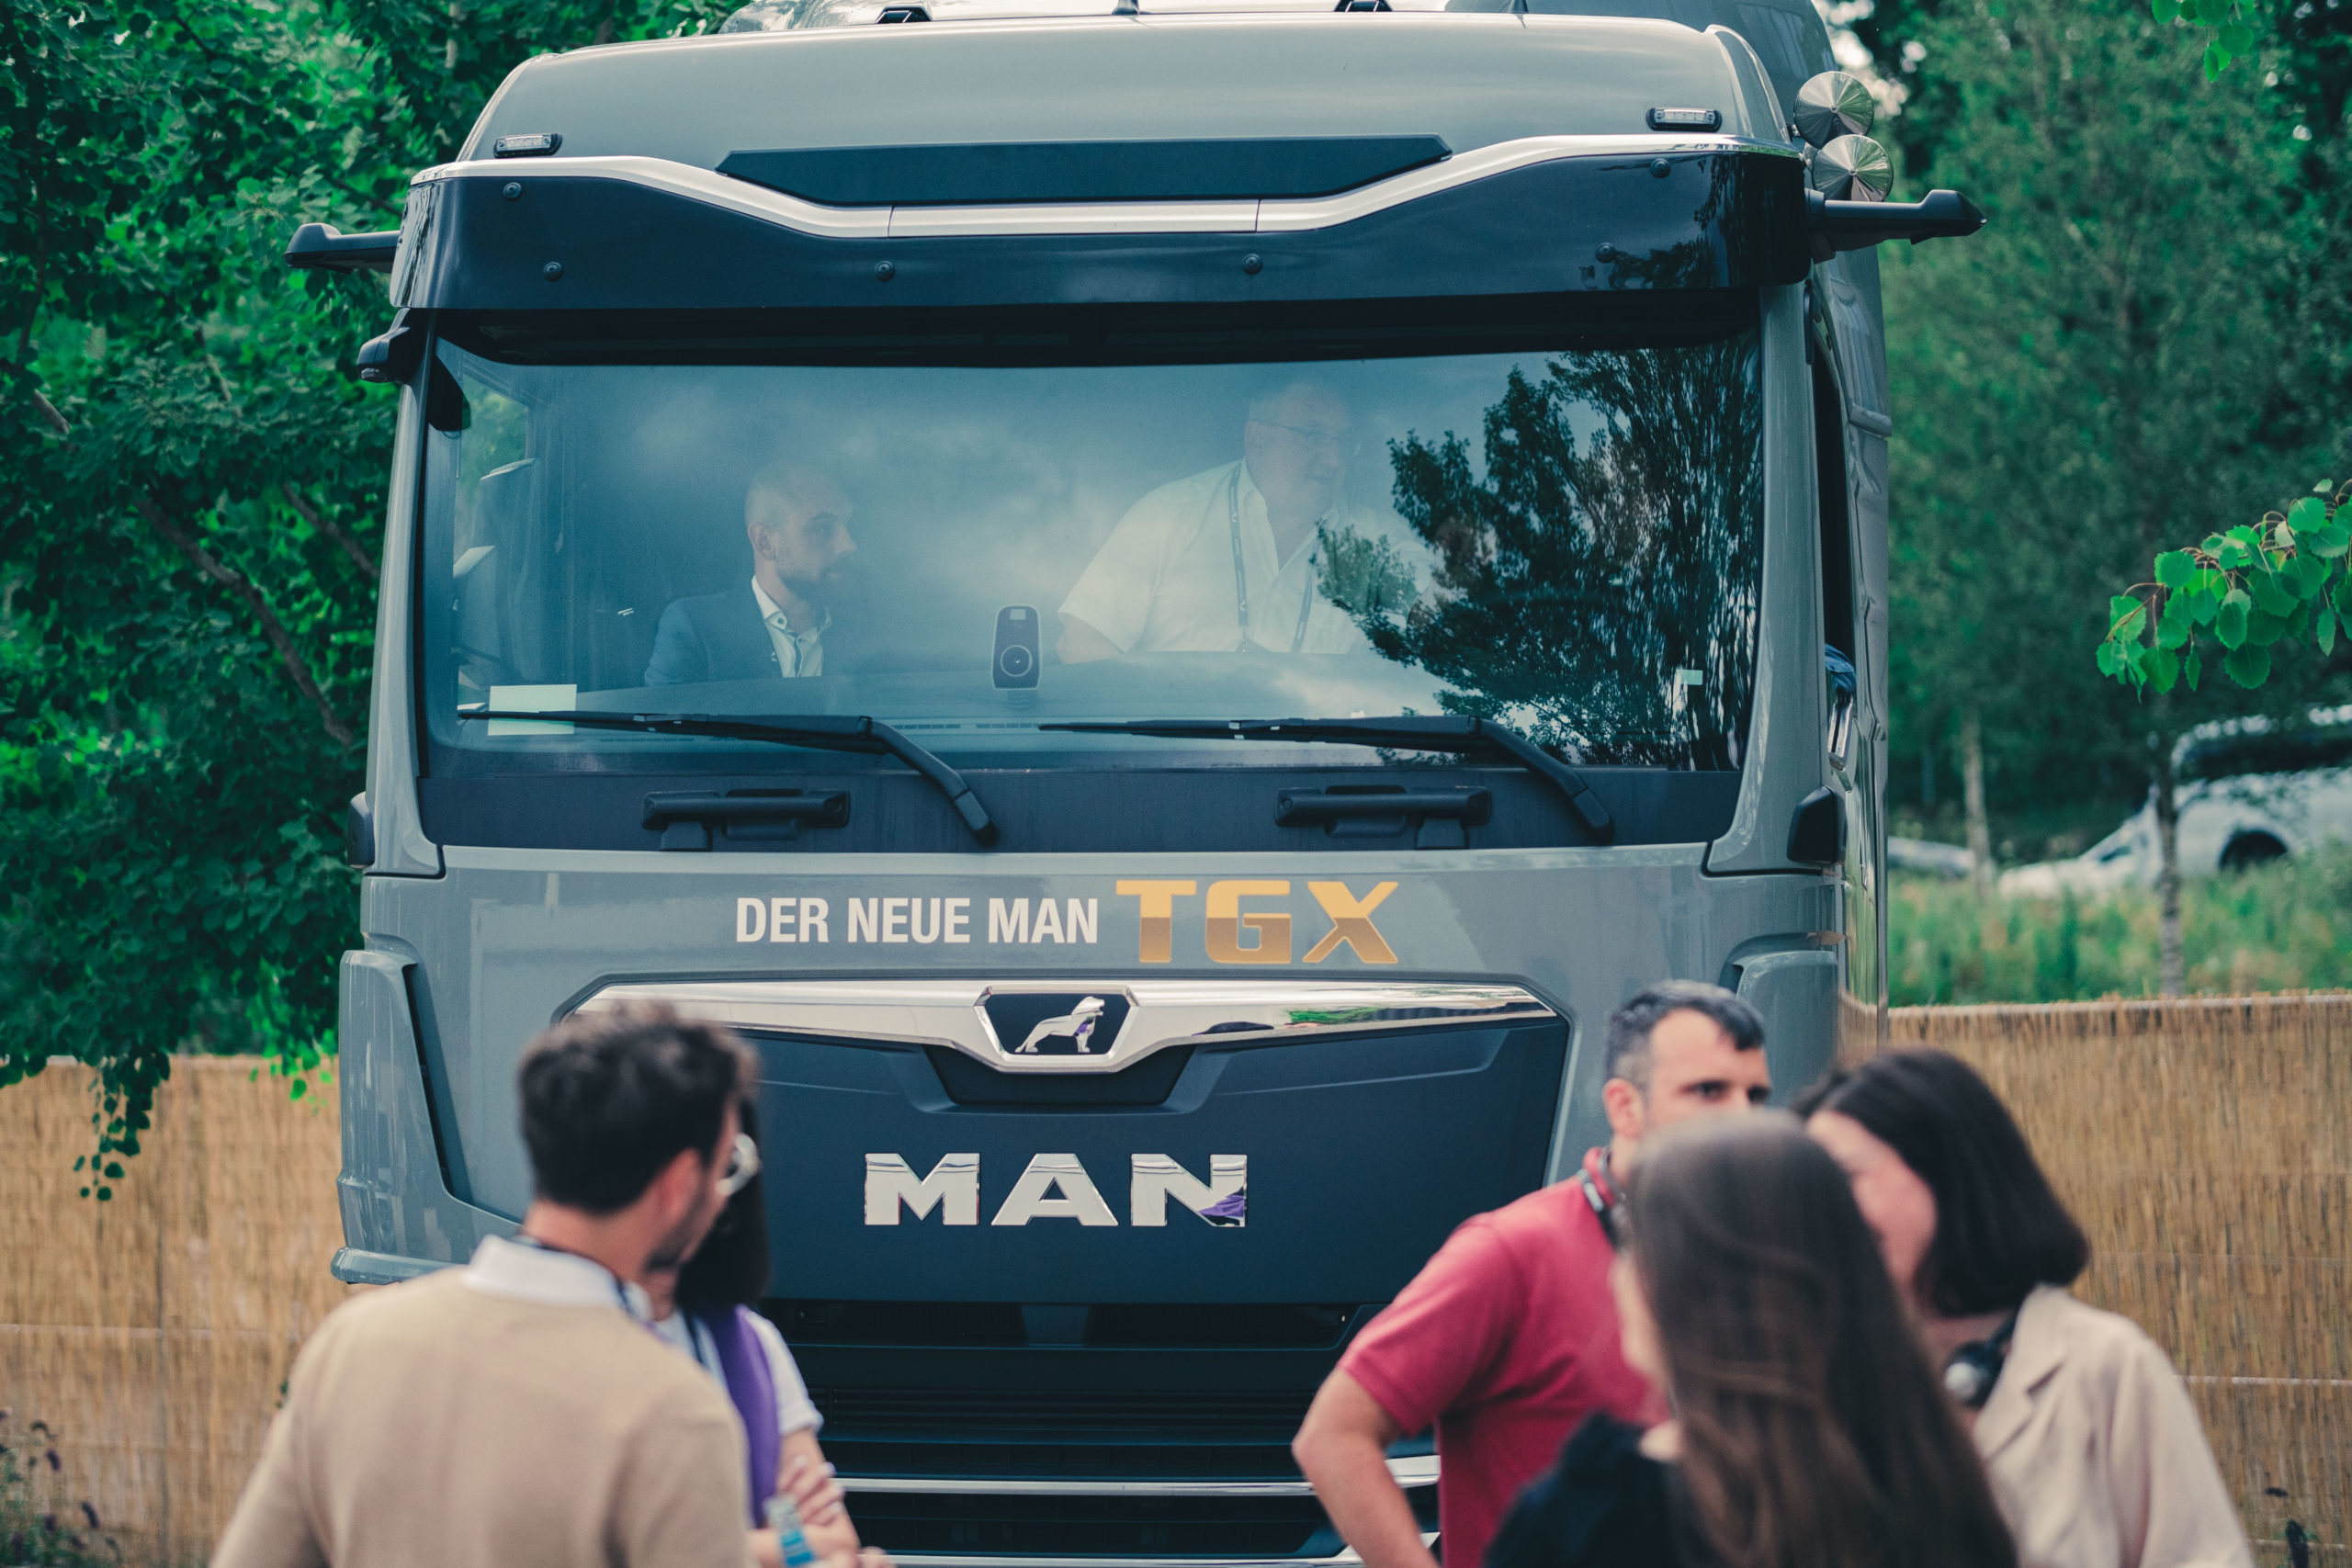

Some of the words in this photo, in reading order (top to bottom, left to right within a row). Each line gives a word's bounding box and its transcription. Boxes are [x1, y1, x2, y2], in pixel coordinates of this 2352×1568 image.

[736, 897, 829, 942] DER
[847, 897, 971, 943] NEUE
[989, 897, 1098, 944] MAN
[1115, 879, 1399, 964] TGX
[865, 1153, 1248, 1227] MAN
